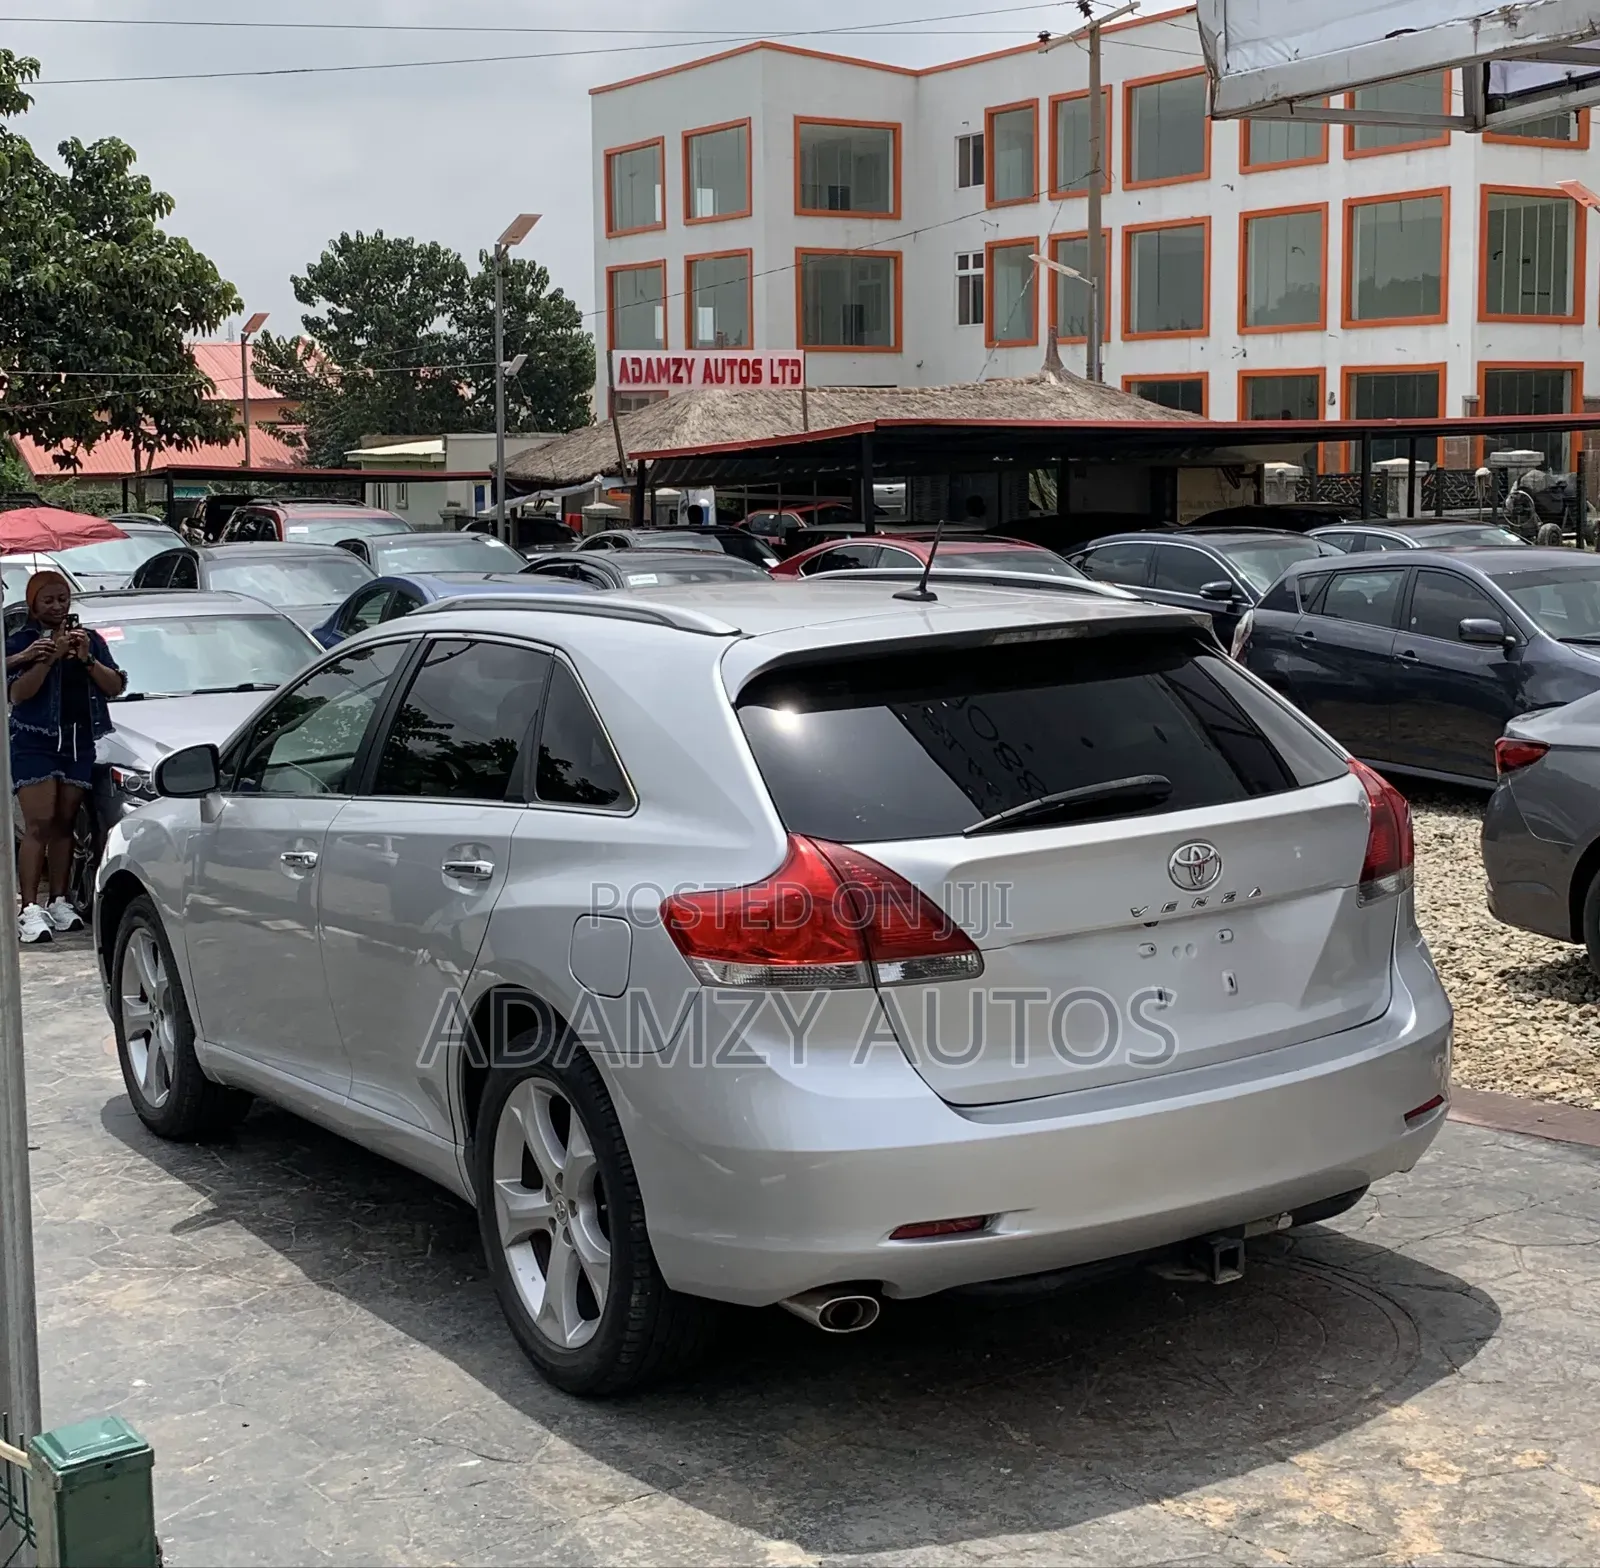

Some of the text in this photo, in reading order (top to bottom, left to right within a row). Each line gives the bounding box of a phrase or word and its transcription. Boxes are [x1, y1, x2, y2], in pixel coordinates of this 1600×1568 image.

[618, 357, 802, 385] ADAMZY AUTOS LTD
[1130, 886, 1262, 917] VENZA
